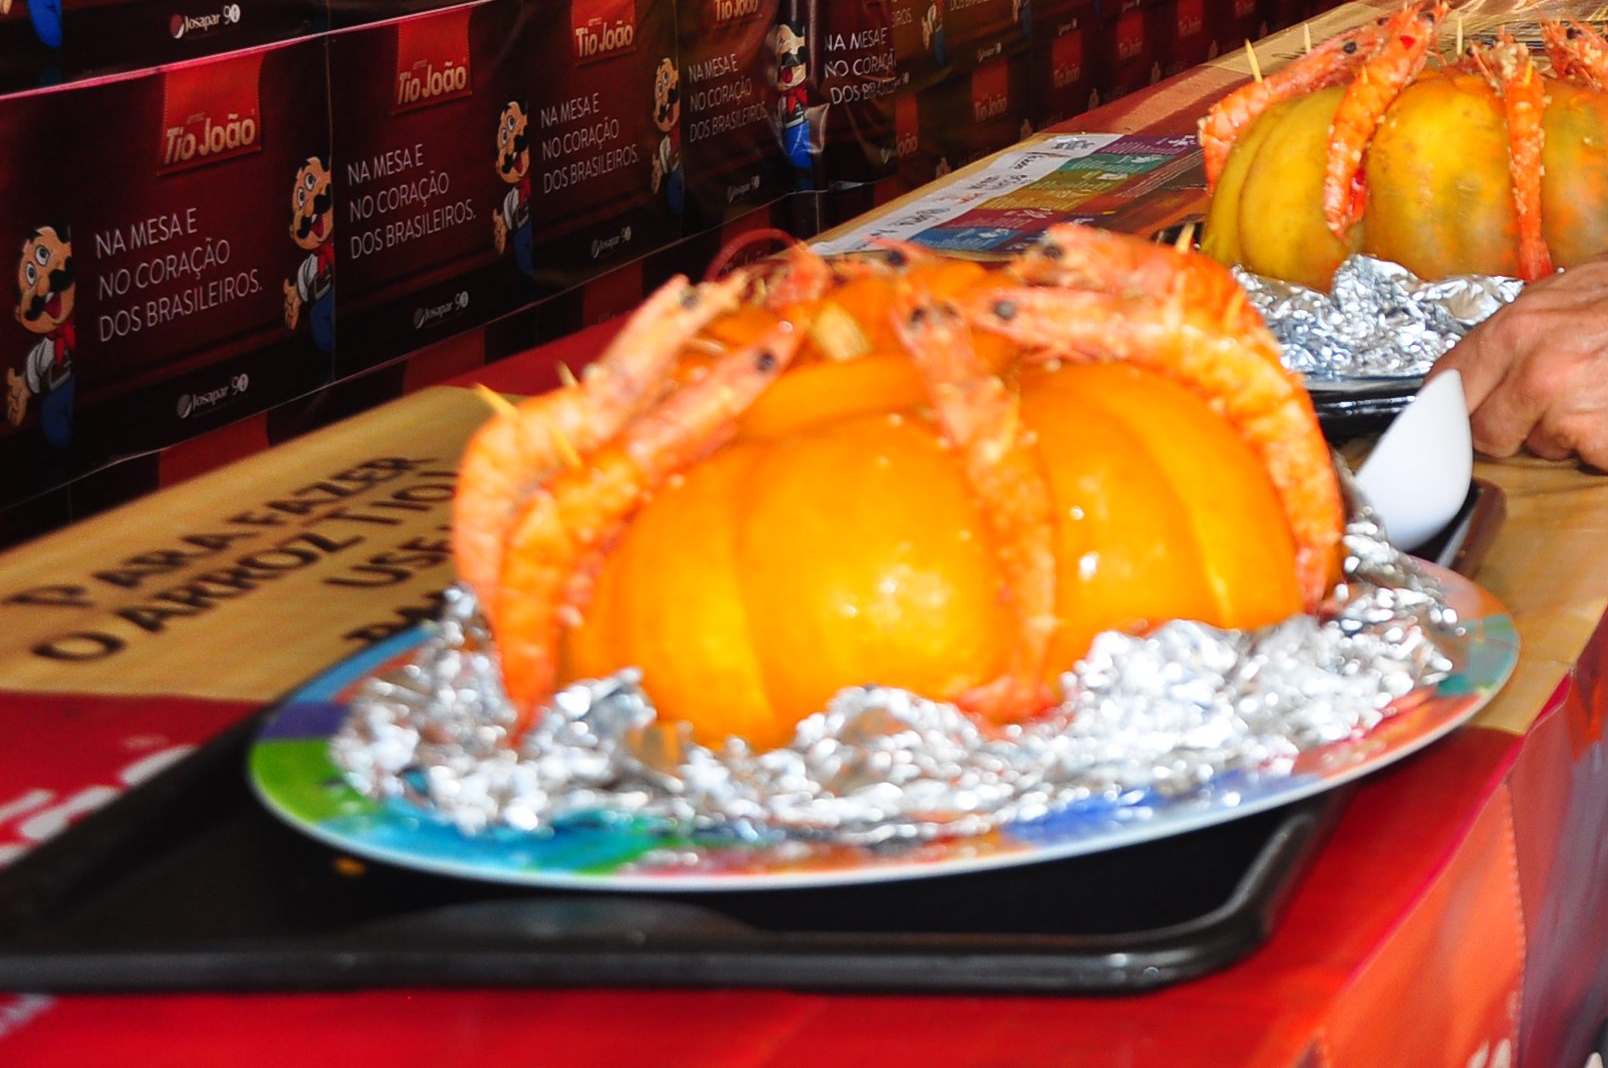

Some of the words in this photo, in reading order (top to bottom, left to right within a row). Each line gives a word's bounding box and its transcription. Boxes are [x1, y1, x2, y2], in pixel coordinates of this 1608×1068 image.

[185, 13, 220, 34] Josapar
[397, 72, 420, 106] Tio
[423, 62, 467, 98] João
[164, 128, 196, 164] Tio
[198, 114, 256, 156] João
[348, 160, 371, 186] NA
[374, 148, 413, 178] MESA
[415, 144, 424, 166] E
[350, 196, 374, 222] NO
[377, 170, 449, 213] CORAÇÃO
[96, 229, 126, 258] NA
[131, 214, 183, 249] MESA
[187, 208, 197, 234] E
[351, 228, 383, 259] DOS
[386, 199, 476, 247] BRASILEIROS.
[100, 269, 130, 300] NO
[136, 238, 230, 288] CORAÇÃO
[100, 306, 142, 342] DOS
[147, 269, 262, 327] BRASILEIROS.
[191, 387, 228, 409] Josapar
[1, 533, 258, 608] PARA
[226, 457, 439, 525] FAZER
[31, 630, 127, 664] O
[114, 534, 366, 633] ARROZ
